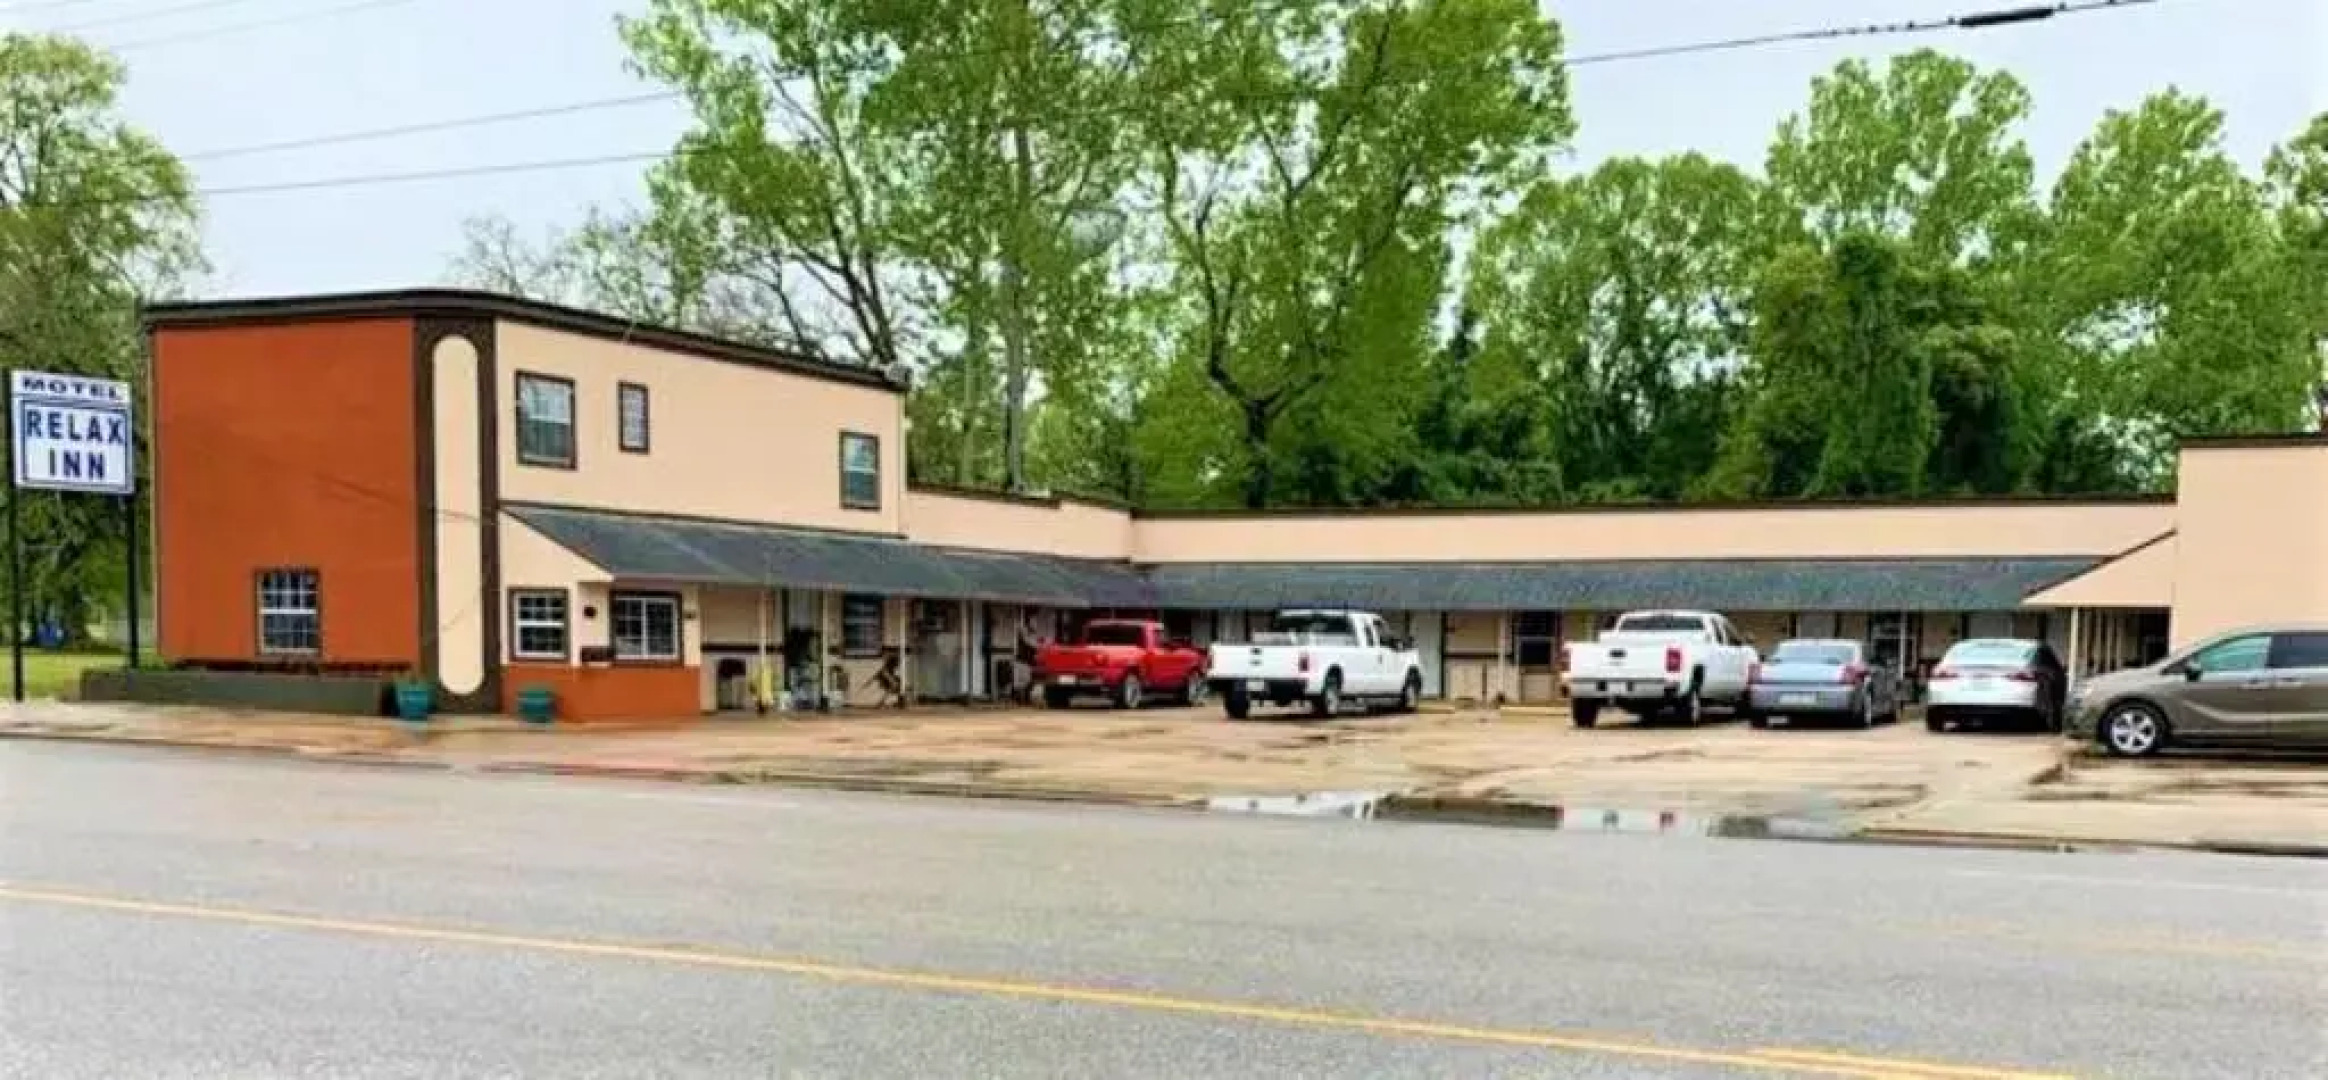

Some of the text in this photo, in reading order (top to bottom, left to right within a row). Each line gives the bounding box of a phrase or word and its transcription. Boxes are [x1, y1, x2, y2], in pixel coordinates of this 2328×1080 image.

[23, 377, 123, 399] MOTEL
[26, 410, 124, 444] RELAX
[49, 448, 105, 478] INN
